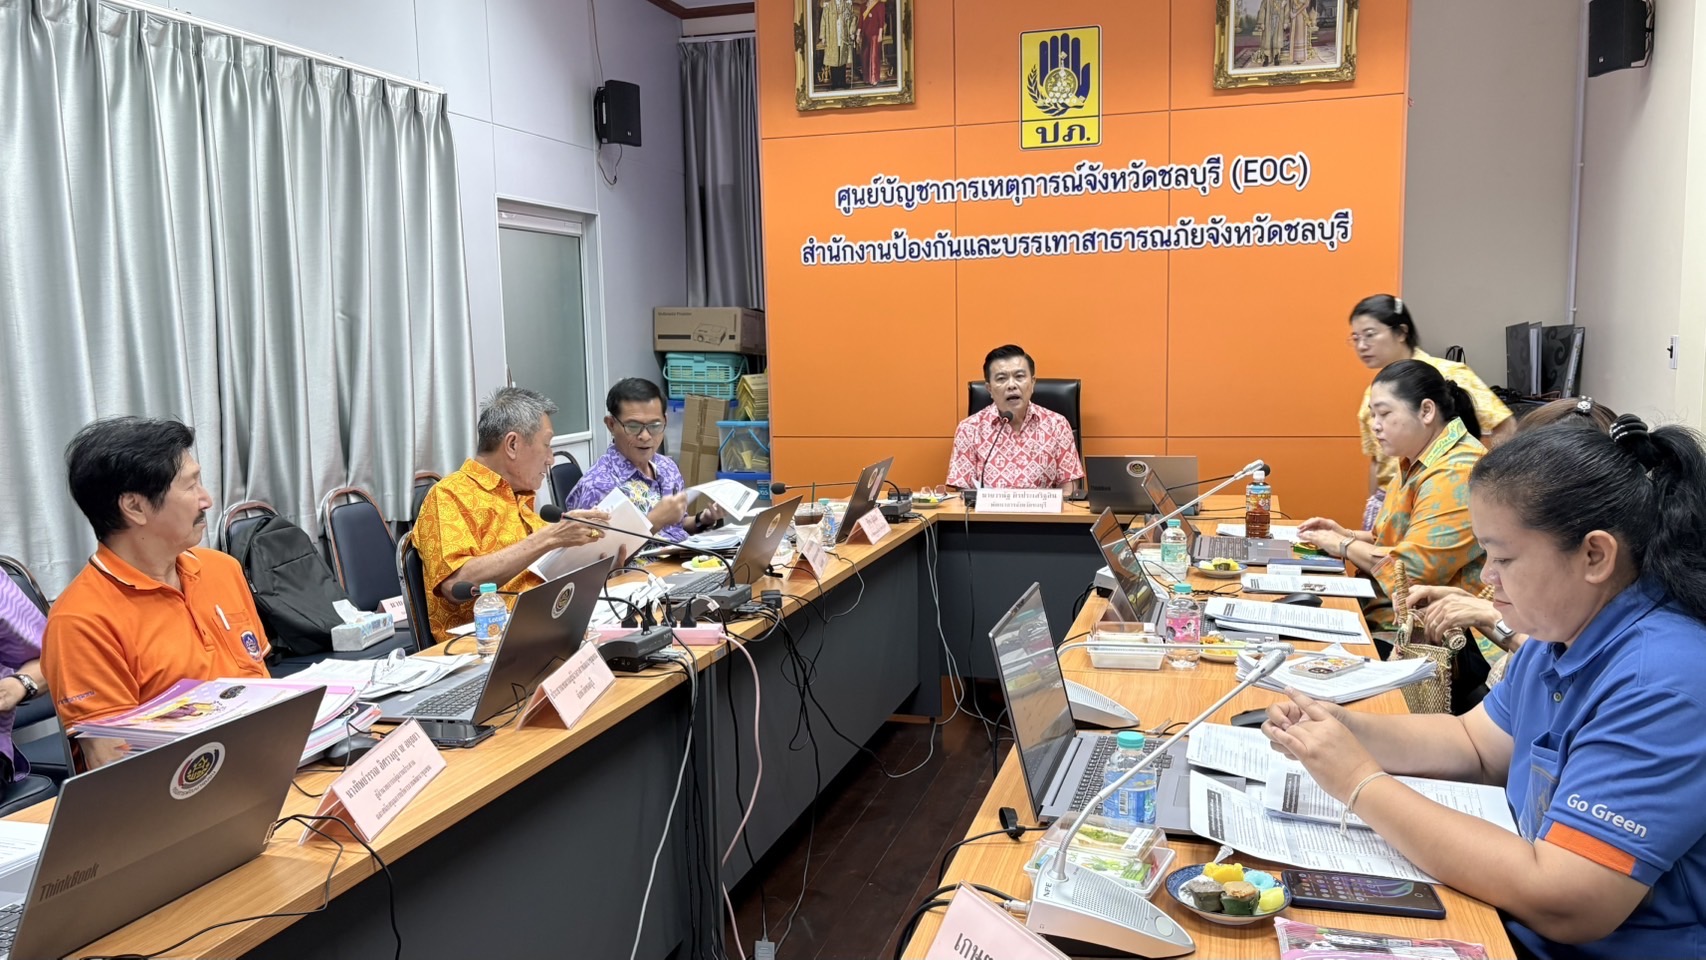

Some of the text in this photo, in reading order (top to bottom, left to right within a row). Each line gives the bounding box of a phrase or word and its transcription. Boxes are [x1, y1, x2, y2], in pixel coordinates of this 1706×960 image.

[1036, 121, 1090, 144] ปภ.
[837, 154, 1309, 214] ศูนย์บัญชาการเหตุการณ์จังหวัดชลบุรี (EOC)
[802, 210, 1351, 264] สำนักงานป้องกันและบรรเทาสาธารณภัยจังหวัดชลบุรี
[405, 731, 421, 749] อยุธยา
[1566, 793, 1647, 838] Go Green
[39, 861, 100, 902] ThinkBook
[1043, 881, 1052, 897] NPE
